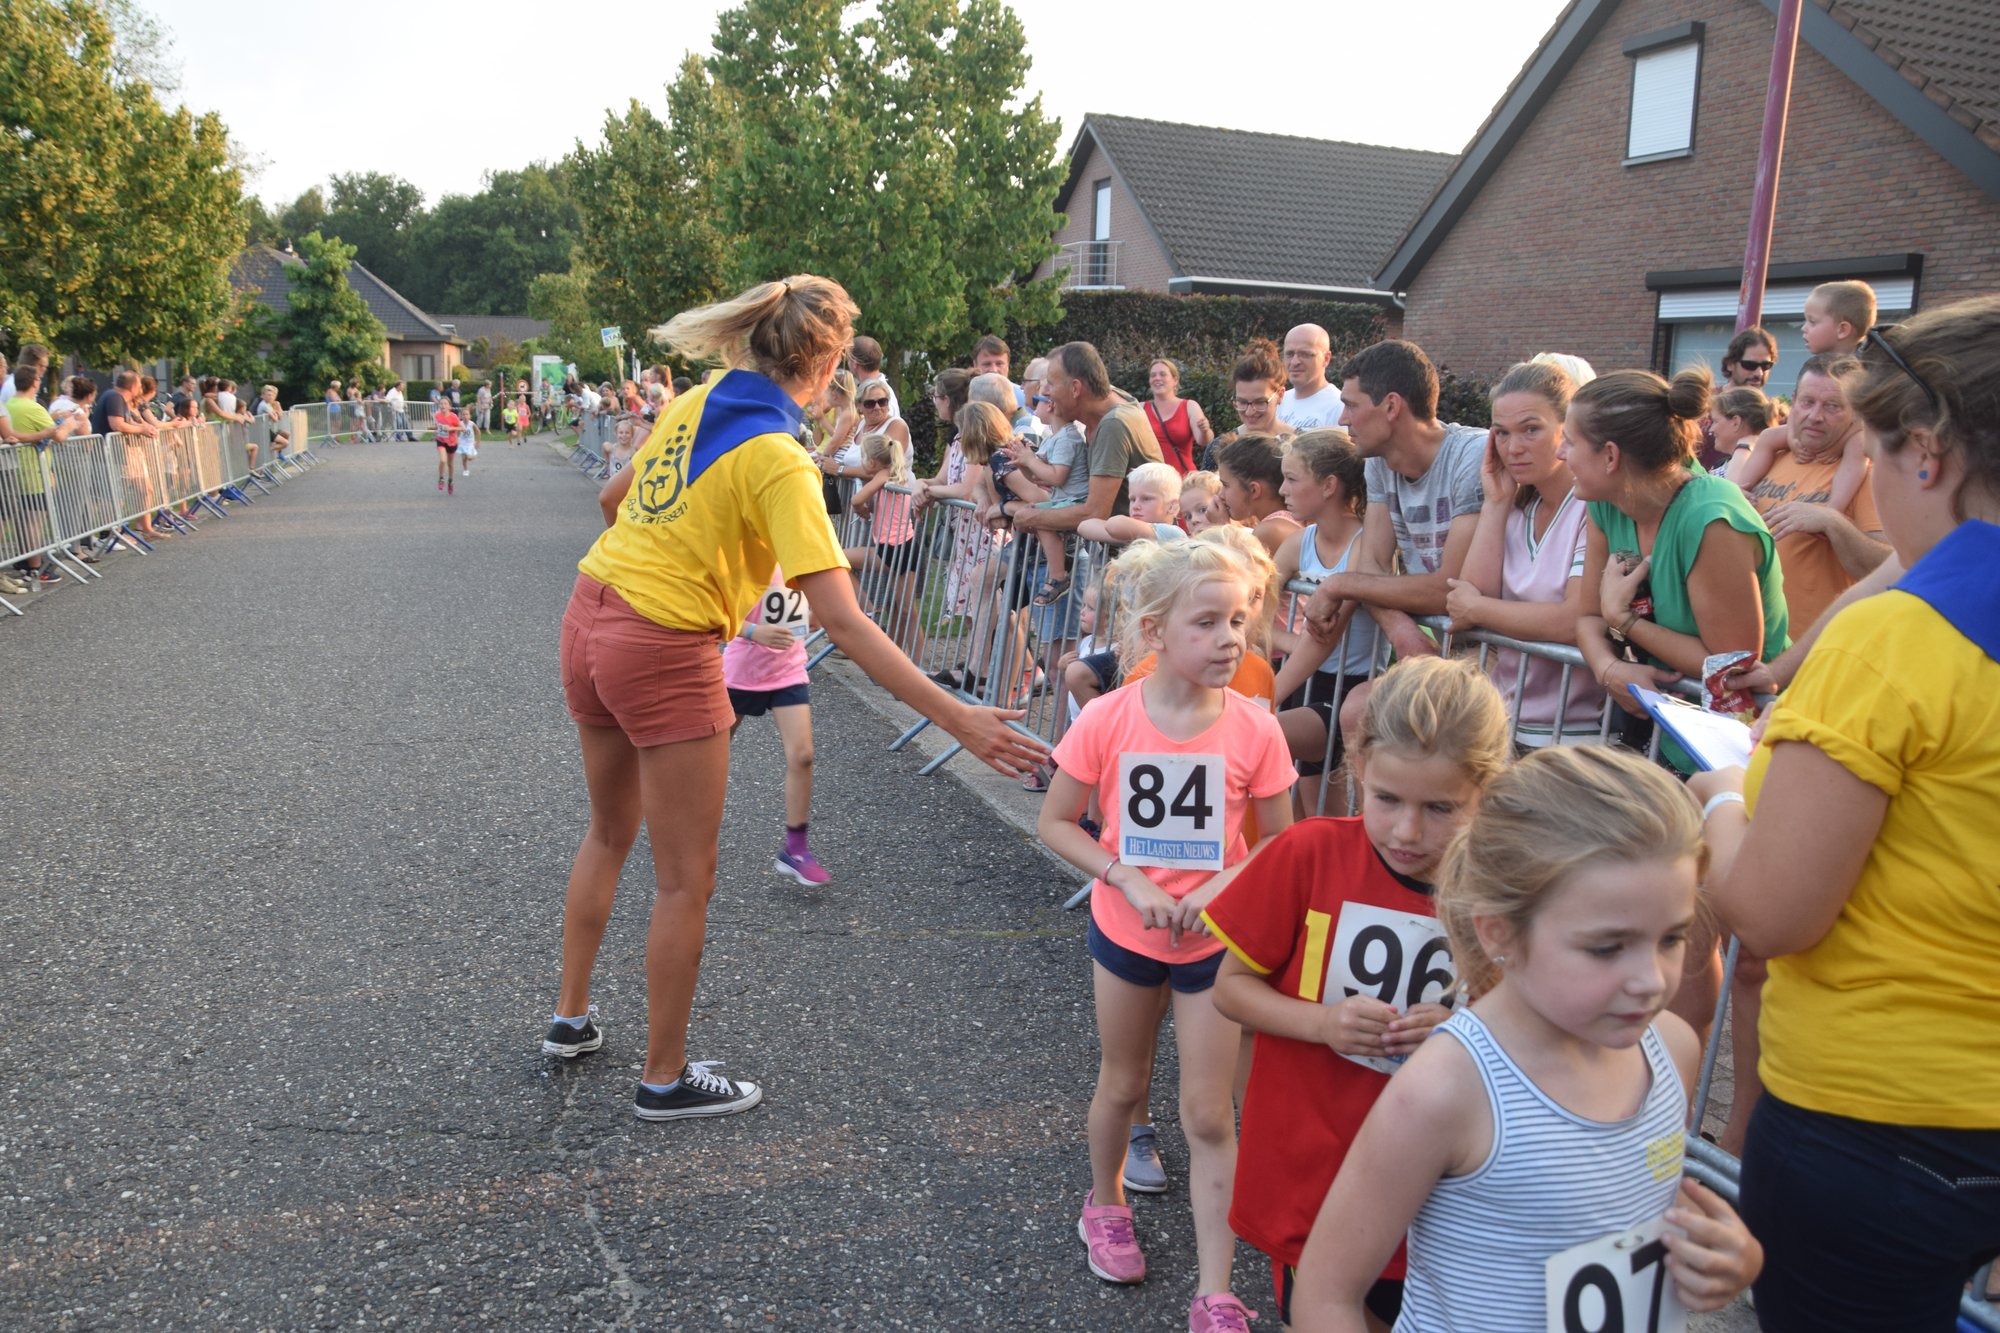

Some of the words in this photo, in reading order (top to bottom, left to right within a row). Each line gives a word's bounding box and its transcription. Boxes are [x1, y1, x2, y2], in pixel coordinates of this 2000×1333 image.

[765, 591, 803, 624] 92
[1128, 764, 1212, 829] 84
[1129, 837, 1147, 855] HET
[1147, 839, 1182, 858] LAATSTE
[1183, 842, 1216, 859] NIEUWS
[1343, 924, 1456, 1008] 96
[1563, 1238, 1670, 1333] 97
